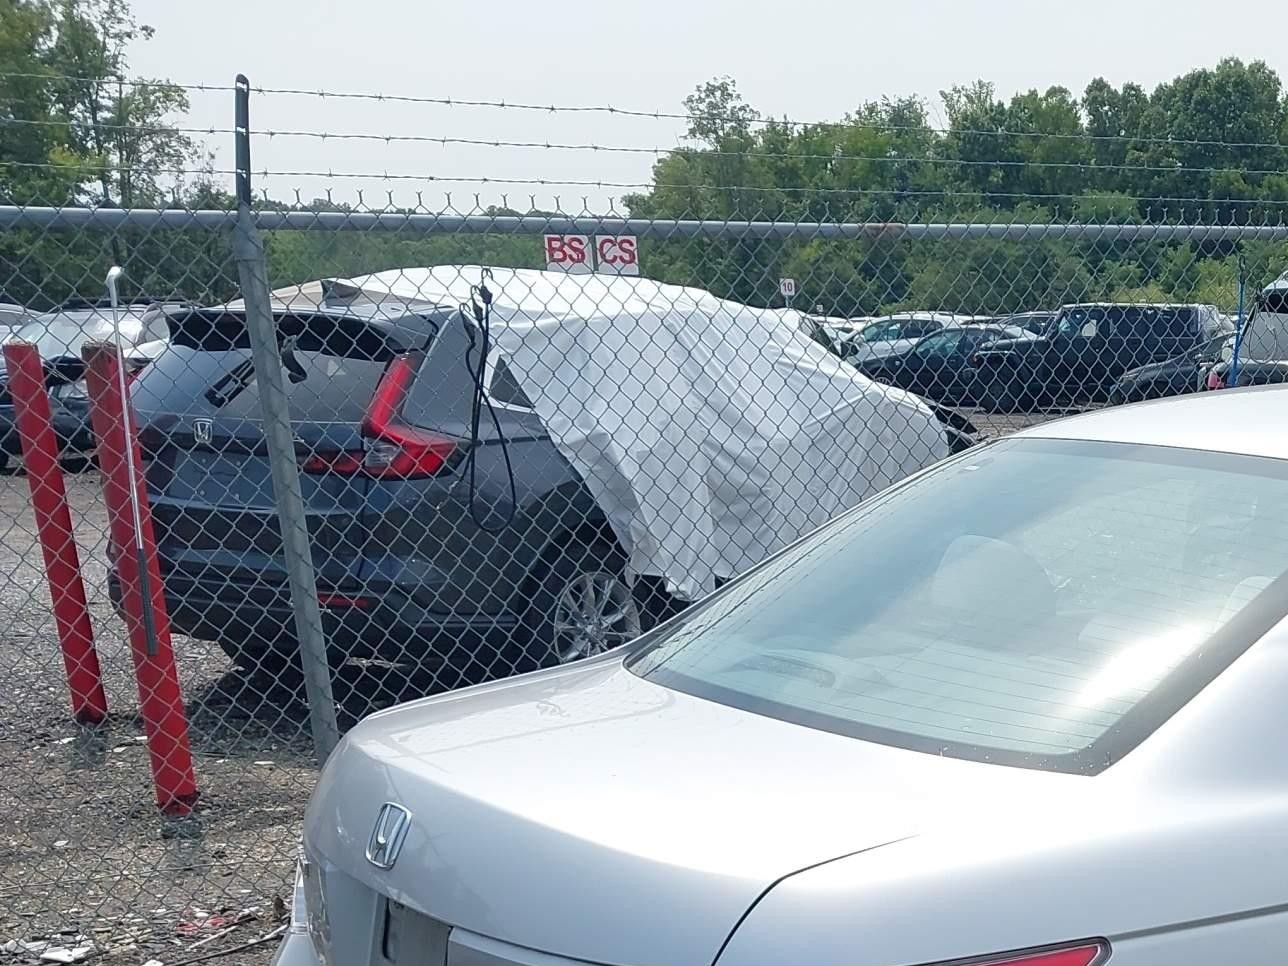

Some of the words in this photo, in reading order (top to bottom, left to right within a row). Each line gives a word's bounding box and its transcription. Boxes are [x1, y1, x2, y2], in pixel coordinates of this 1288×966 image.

[547, 237, 586, 263] BS
[599, 238, 636, 264] CS
[783, 282, 793, 292] 10
